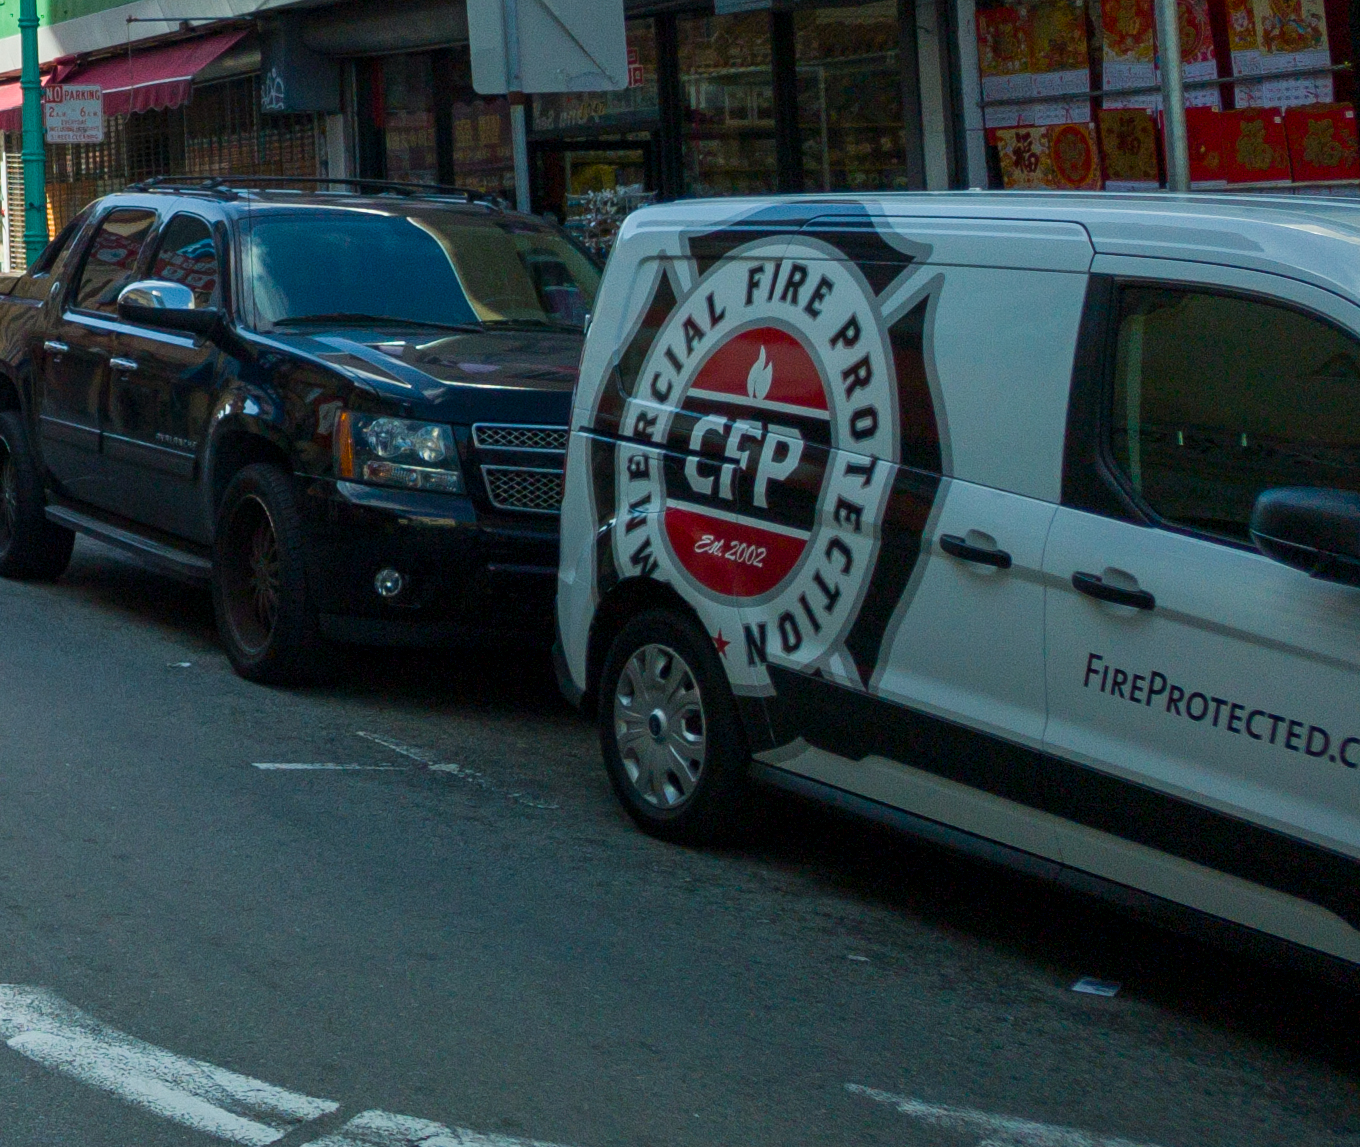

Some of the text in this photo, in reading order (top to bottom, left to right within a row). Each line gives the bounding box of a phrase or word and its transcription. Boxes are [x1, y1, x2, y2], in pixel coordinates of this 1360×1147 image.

[46, 86, 100, 102] NO PARKING
[743, 262, 835, 320] FIRE
[683, 412, 805, 509] CFP
[743, 312, 880, 668] PROTECTION
[693, 533, 768, 568] Est. 2002
